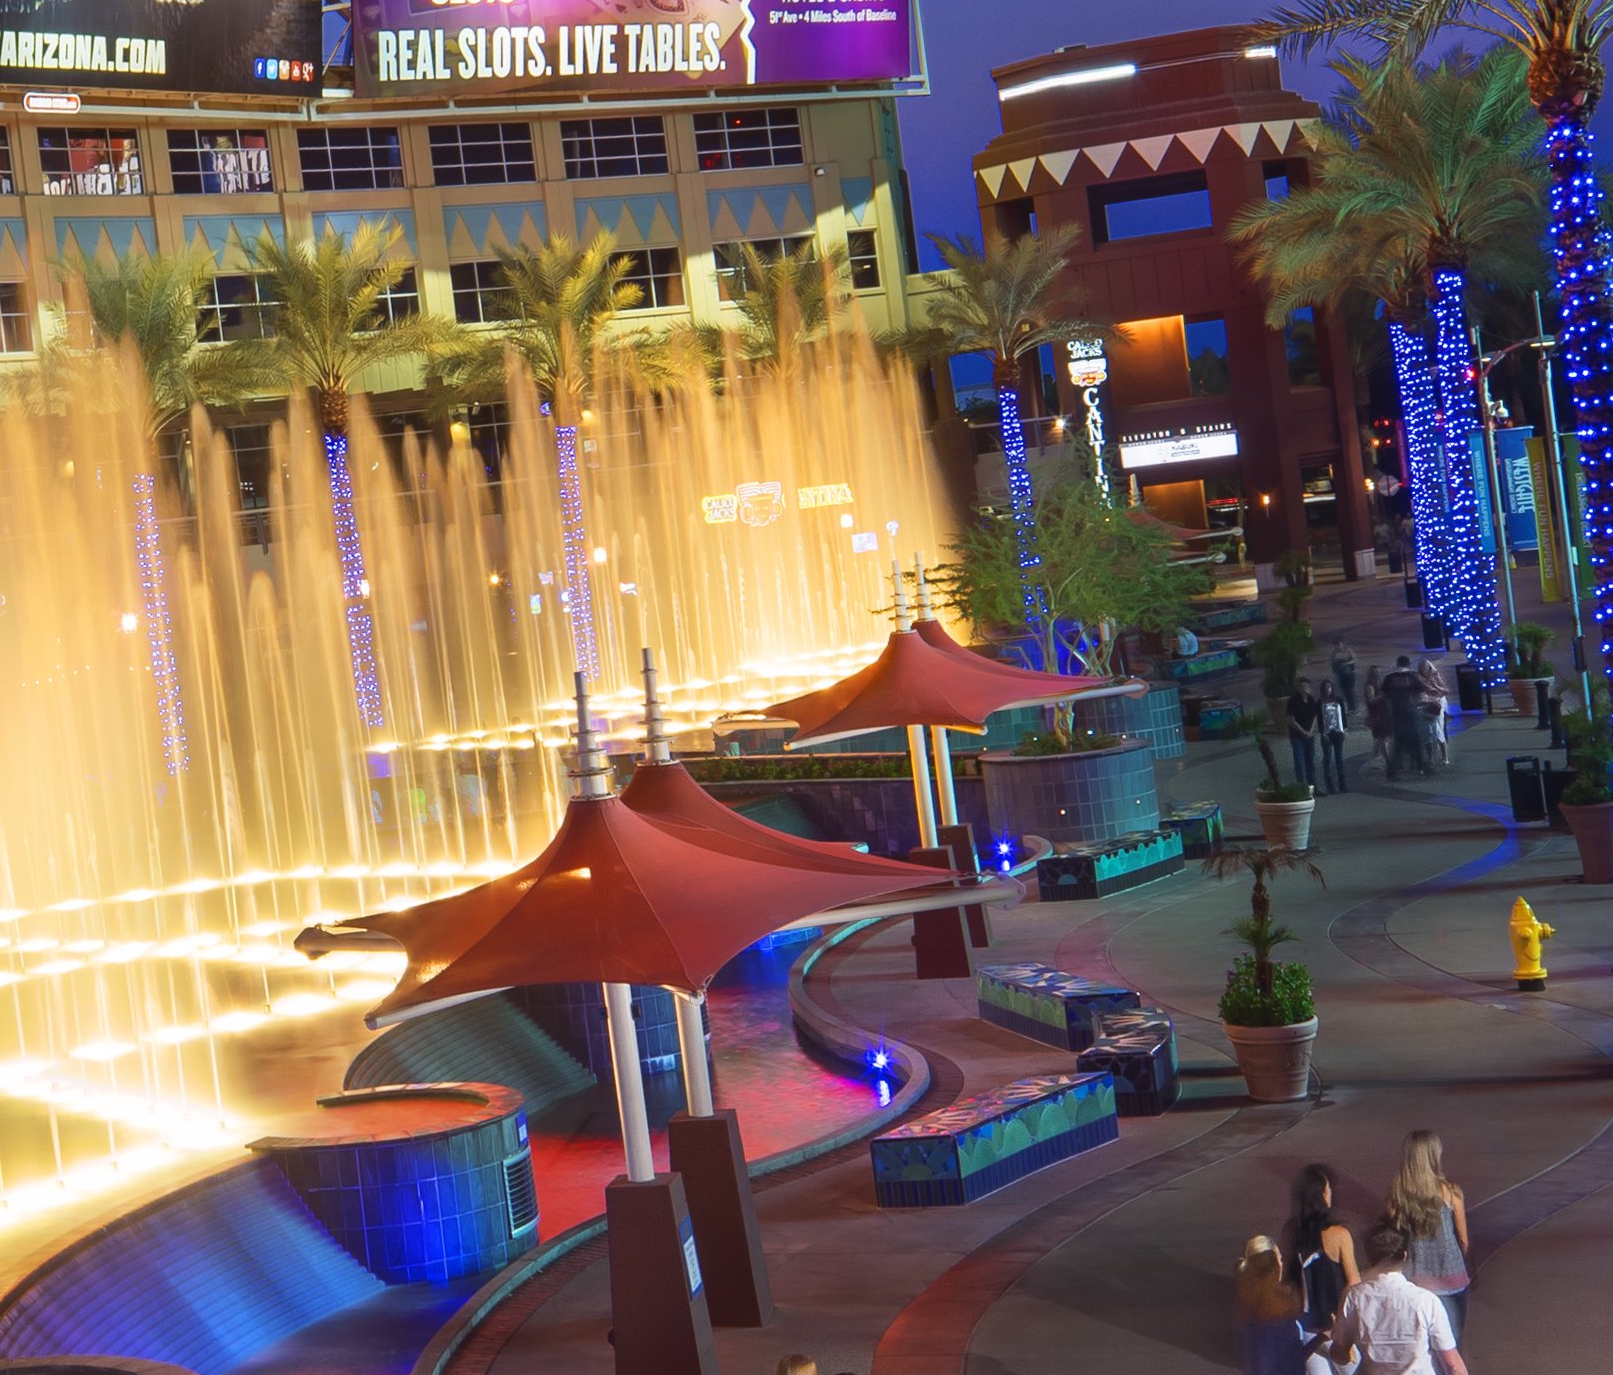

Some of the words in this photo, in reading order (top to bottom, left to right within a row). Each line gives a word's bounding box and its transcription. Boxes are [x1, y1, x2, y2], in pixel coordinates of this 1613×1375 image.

[783, 11, 797, 23] Ave
[810, 10, 832, 23] Miles
[832, 9, 856, 22] South
[856, 9, 865, 21] of
[866, 9, 897, 21] Baseline
[378, 28, 452, 82] REAL
[457, 26, 553, 80] SLOTS.
[558, 25, 620, 77] LIVE
[622, 21, 726, 74] TABLES.
[1070, 348, 1103, 359] JACKS
[1474, 450, 1483, 478] WHERE
[1478, 481, 1486, 497] FUN
[1512, 456, 1536, 514] WESTGATE
[1533, 461, 1546, 501] WHERE
[1480, 499, 1490, 536] HAPPENS
[1538, 504, 1549, 525] FUN
[1541, 528, 1555, 579] HAPPENS
